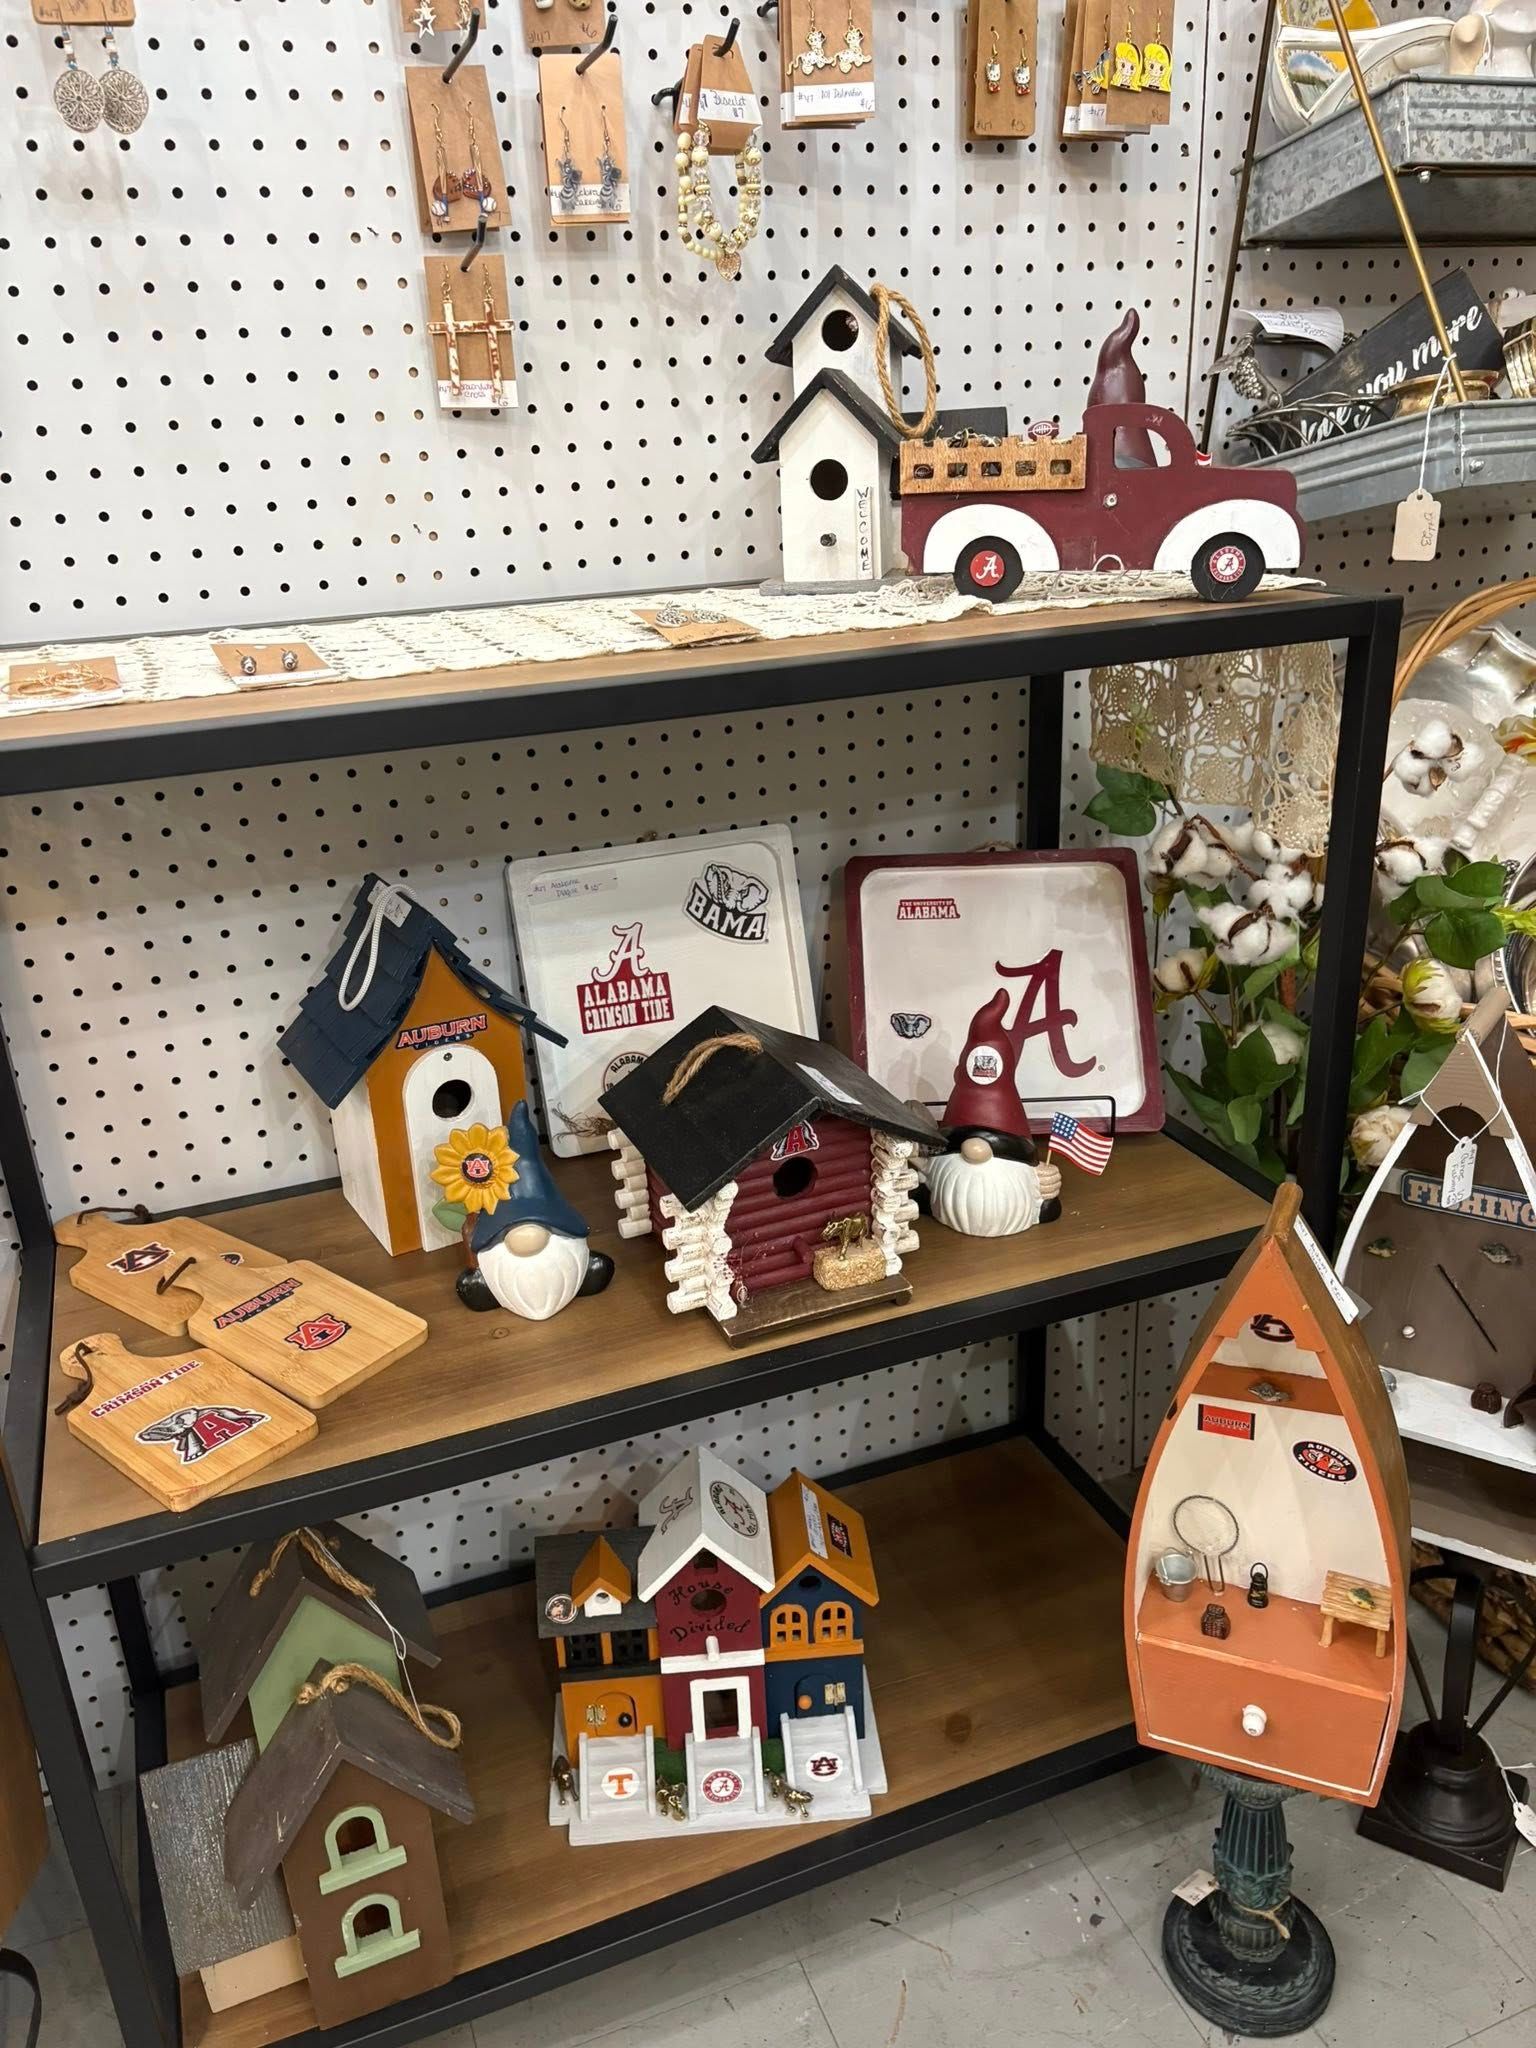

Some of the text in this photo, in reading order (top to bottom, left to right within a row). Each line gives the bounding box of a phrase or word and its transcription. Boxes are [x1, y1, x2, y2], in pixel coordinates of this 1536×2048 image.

[856, 486, 871, 571] WELCOME
[975, 554, 1000, 580] A
[687, 888, 766, 938] BAMA
[899, 905, 958, 919] ALABAMA
[591, 922, 651, 983] A
[583, 974, 668, 1009] ALABAMA
[584, 997, 671, 1032] CRIMSON TIDE
[994, 949, 1098, 1079] A
[397, 1014, 488, 1048] AUBURN
[414, 1033, 472, 1049] TIGERS
[610, 1054, 646, 1074] ALABAM
[216, 1278, 300, 1329] AUBURN
[90, 1379, 163, 1417] CRIMSON
[160, 1360, 200, 1381] TIDE
[1204, 1415, 1250, 1429] AUBURN
[1297, 1453, 1347, 1480] TIGERS
[1307, 1443, 1351, 1466] AUBURN
[668, 1581, 734, 1607] House
[669, 1615, 752, 1643] Divided
[608, 1773, 633, 1795] T
